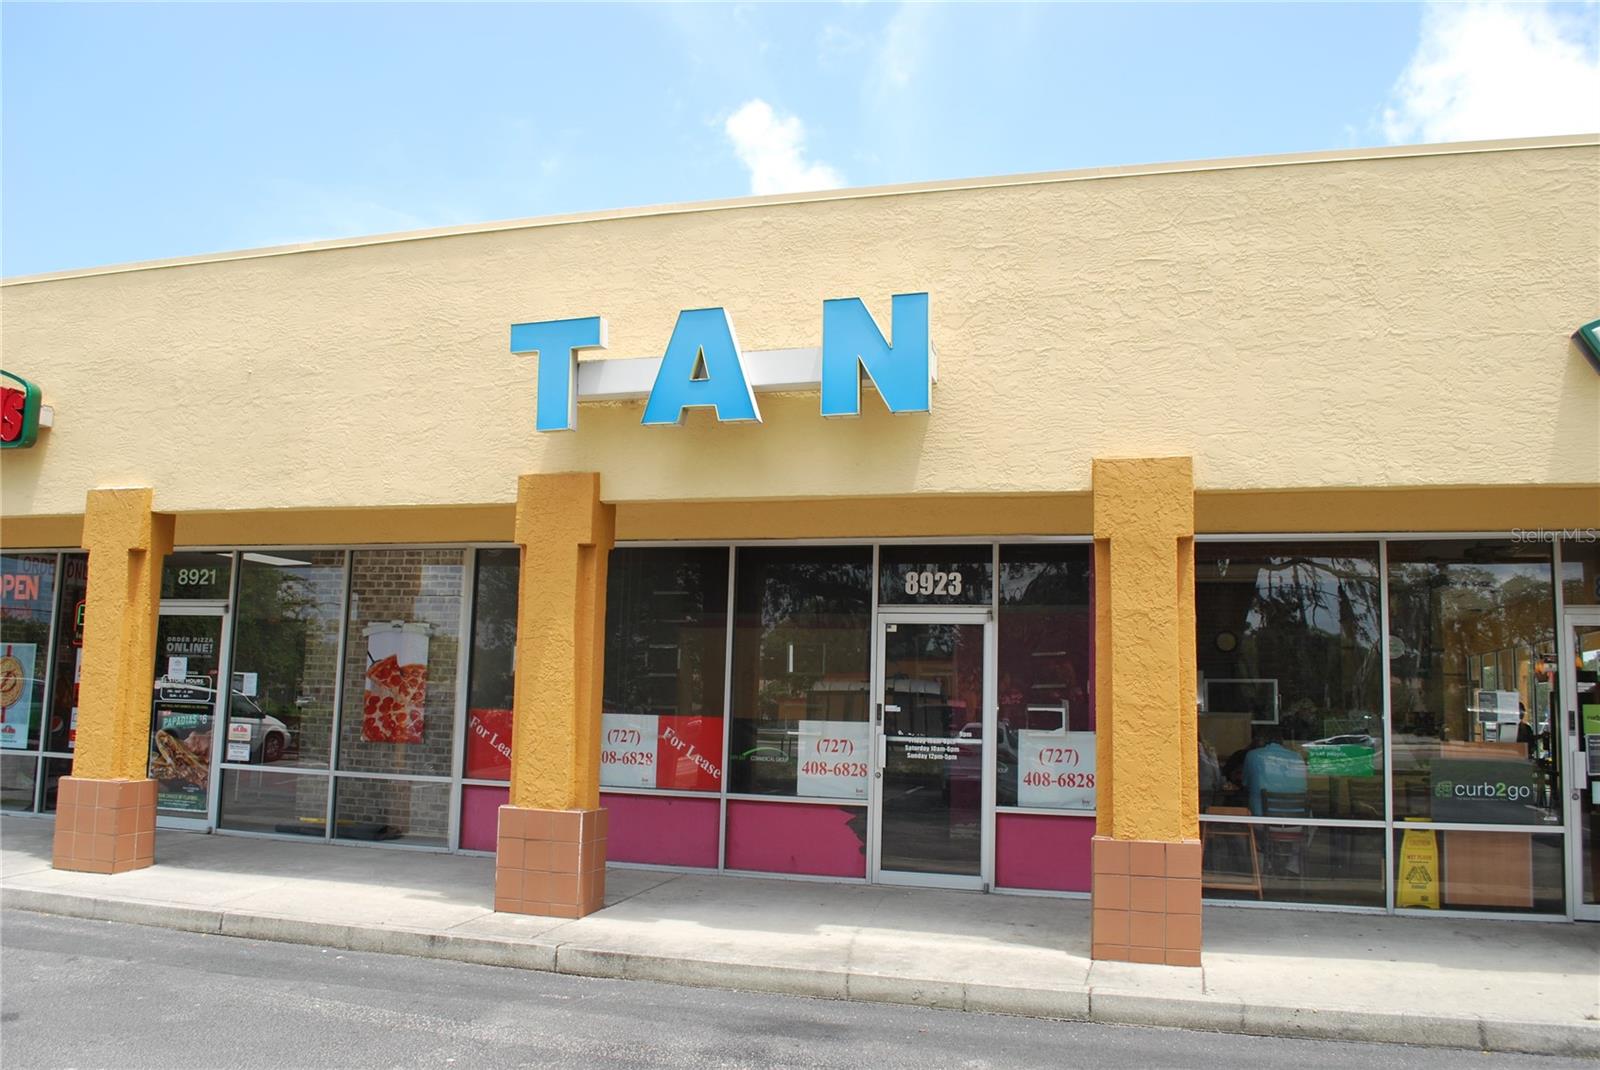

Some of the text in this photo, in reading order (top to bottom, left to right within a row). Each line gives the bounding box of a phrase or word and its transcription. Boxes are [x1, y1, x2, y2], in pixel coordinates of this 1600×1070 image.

[510, 292, 936, 432] TAN
[23, 556, 57, 576] ORDE
[178, 568, 216, 585] 8921
[905, 571, 962, 596] 8923
[0, 574, 40, 601] PEN
[166, 642, 213, 653] ONLINE!
[470, 716, 490, 738] For
[607, 729, 641, 745] (727)
[663, 726, 721, 779] For Lease
[816, 738, 854, 757] (727)
[907, 752, 928, 760] Sunday
[600, 750, 653, 766] 08-6828
[1039, 748, 1079, 767] (727)
[802, 761, 868, 777] 408-6828
[1023, 771, 1095, 789] 408-6828
[1454, 782, 1530, 800] curb2go
